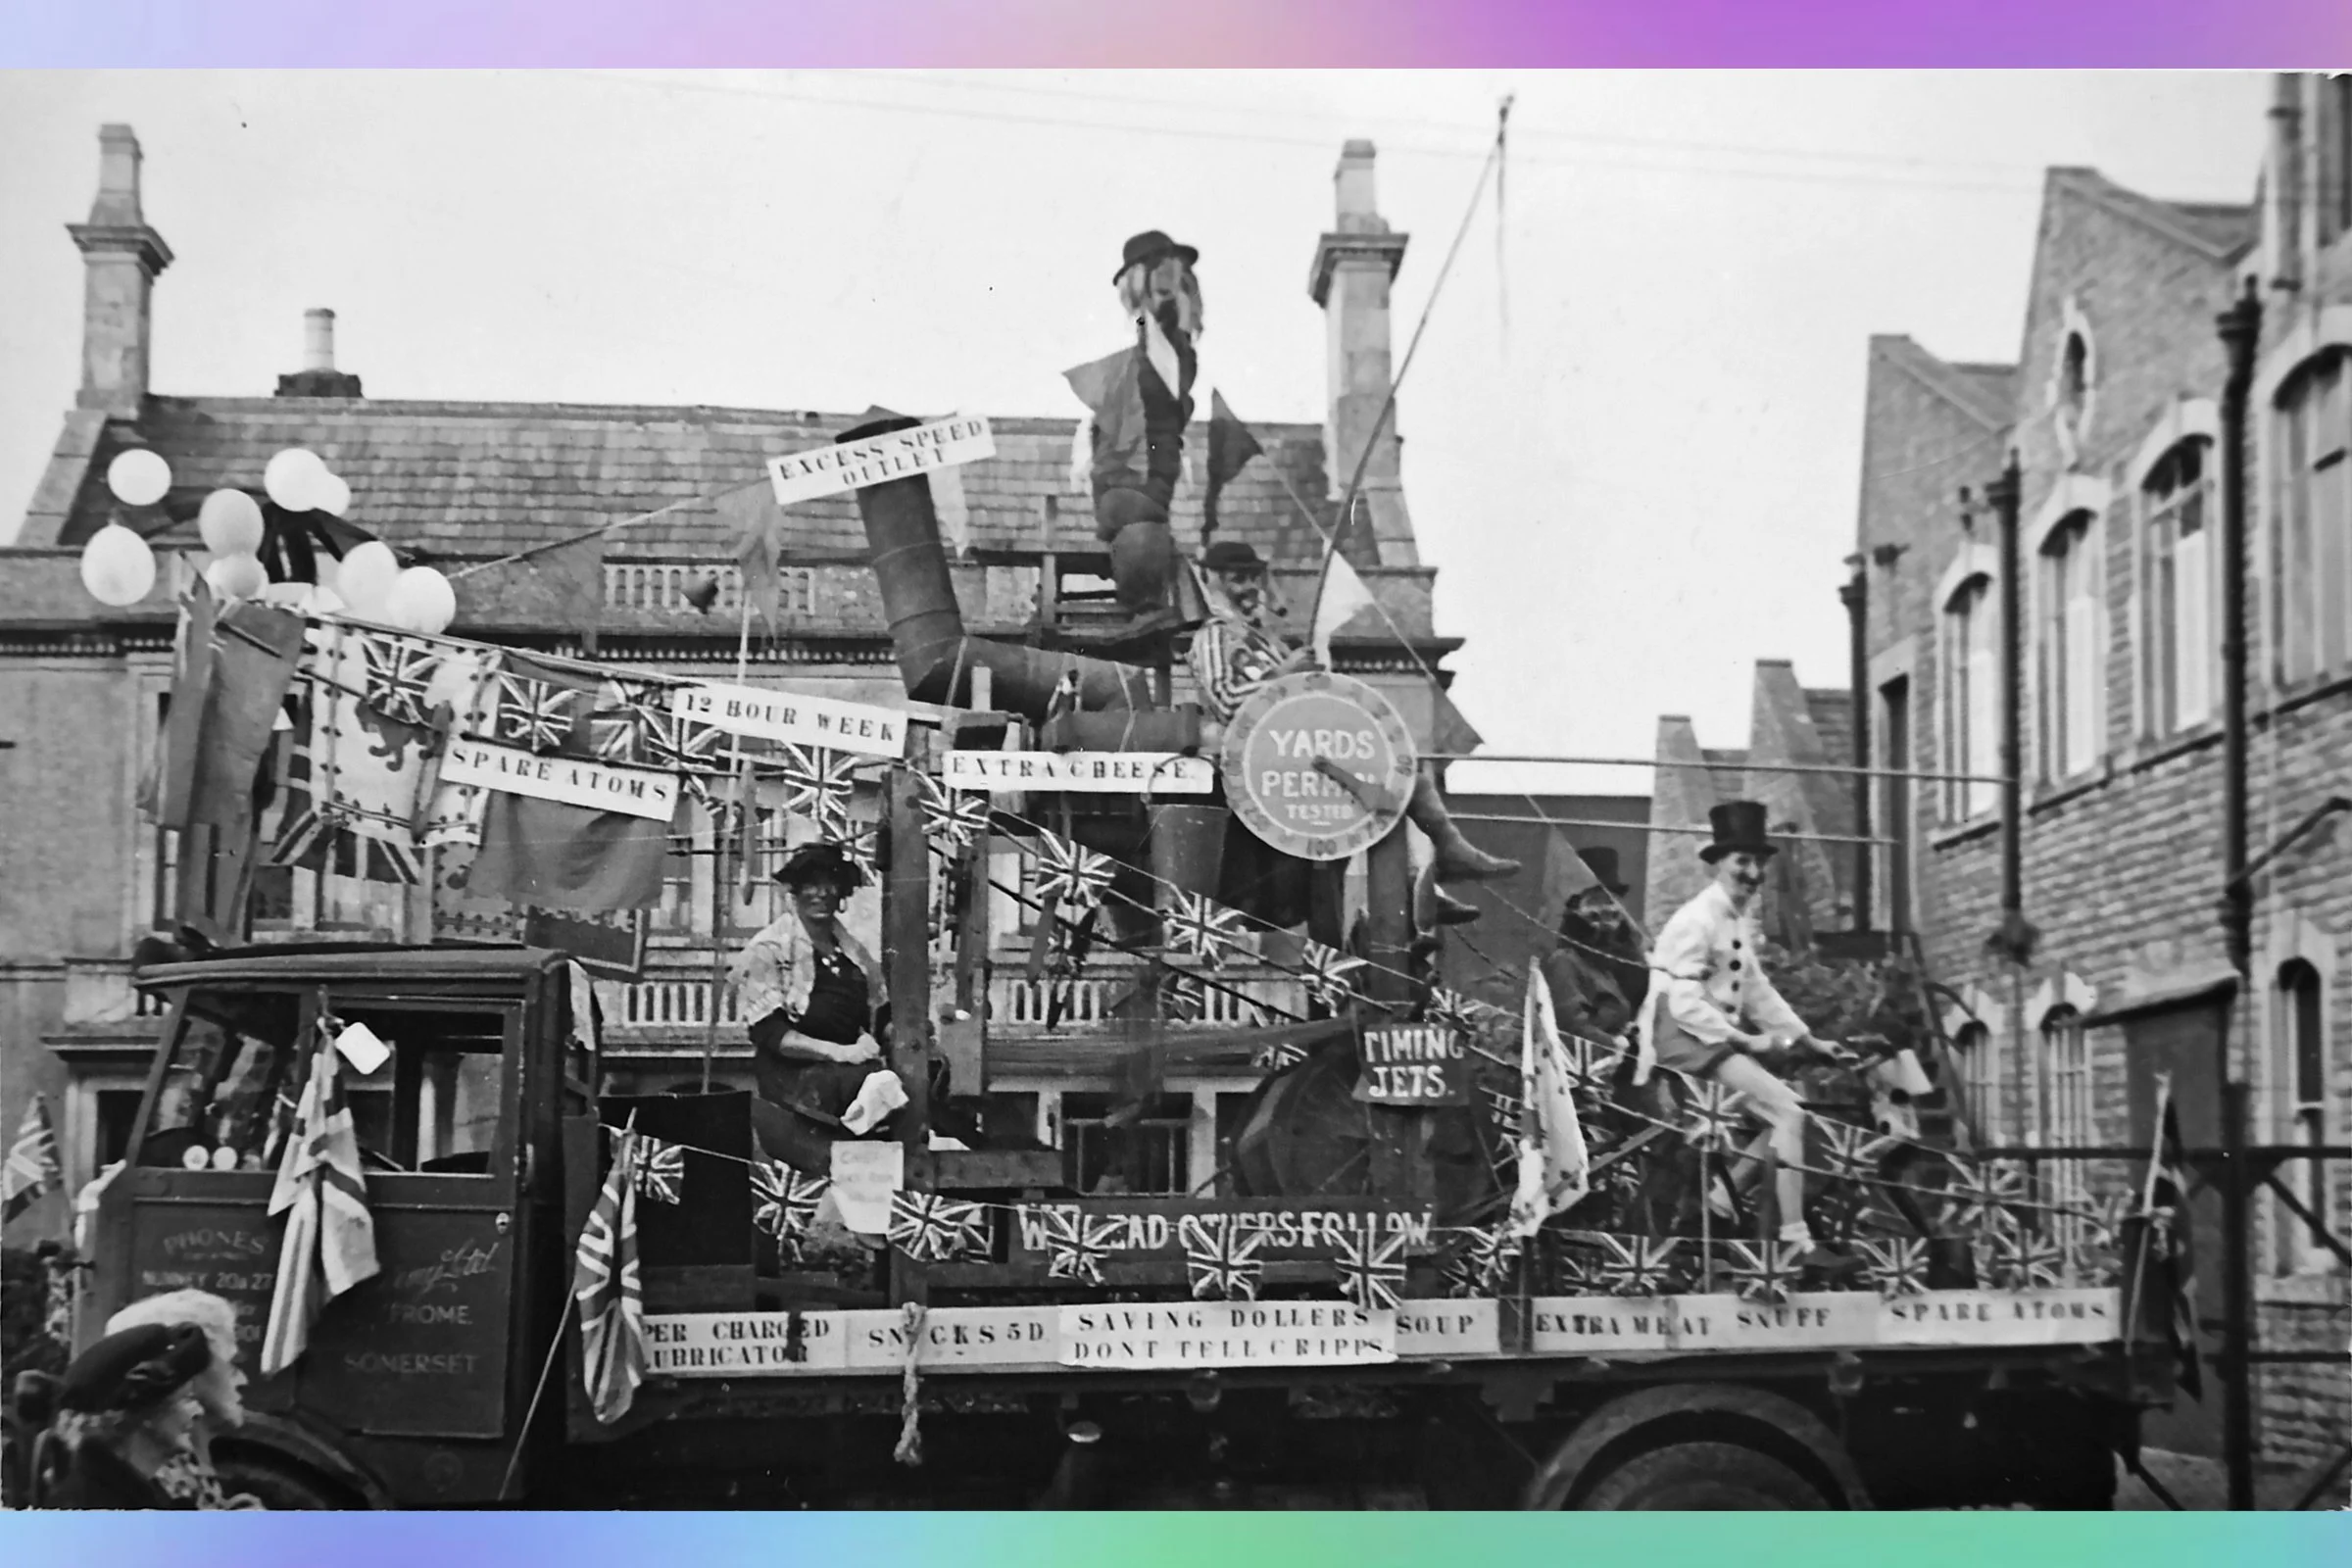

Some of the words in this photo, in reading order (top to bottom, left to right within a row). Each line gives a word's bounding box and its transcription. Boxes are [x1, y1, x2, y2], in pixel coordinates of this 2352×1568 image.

[778, 443, 884, 481] EXCESS
[898, 419, 983, 448] SPEED
[842, 447, 944, 486] OUTLET
[686, 693, 712, 712] 12
[725, 699, 798, 725] HOUR
[816, 712, 897, 742] WEEK
[1268, 728, 1376, 760] YARDS
[452, 748, 553, 782] SPARE
[564, 768, 668, 801] ATOMS
[953, 757, 1055, 778] EXTRA
[1284, 804, 1356, 820] TESTED
[1363, 1027, 1465, 1063] TIMING
[1016, 1203, 1082, 1250] W
[1084, 1213, 1169, 1250] EAD
[163, 1227, 270, 1255] PHONES
[1078, 1308, 1203, 1332] SAVING
[1231, 1308, 1369, 1328] DOLLERS
[1737, 1306, 1832, 1330] SNUFF
[1891, 1301, 1991, 1323] SPARE
[2013, 1299, 2106, 1321] ATOMS
[868, 1324, 996, 1349] SNCKS
[1396, 1314, 1474, 1336] SOUP
[1536, 1313, 1622, 1336] EXTRA
[1633, 1314, 1711, 1337] MEAT
[644, 1345, 808, 1370] UBRICATOR
[1074, 1340, 1159, 1359] DONT
[1180, 1339, 1256, 1359] TELL
[342, 1352, 481, 1374] SOMERSET
